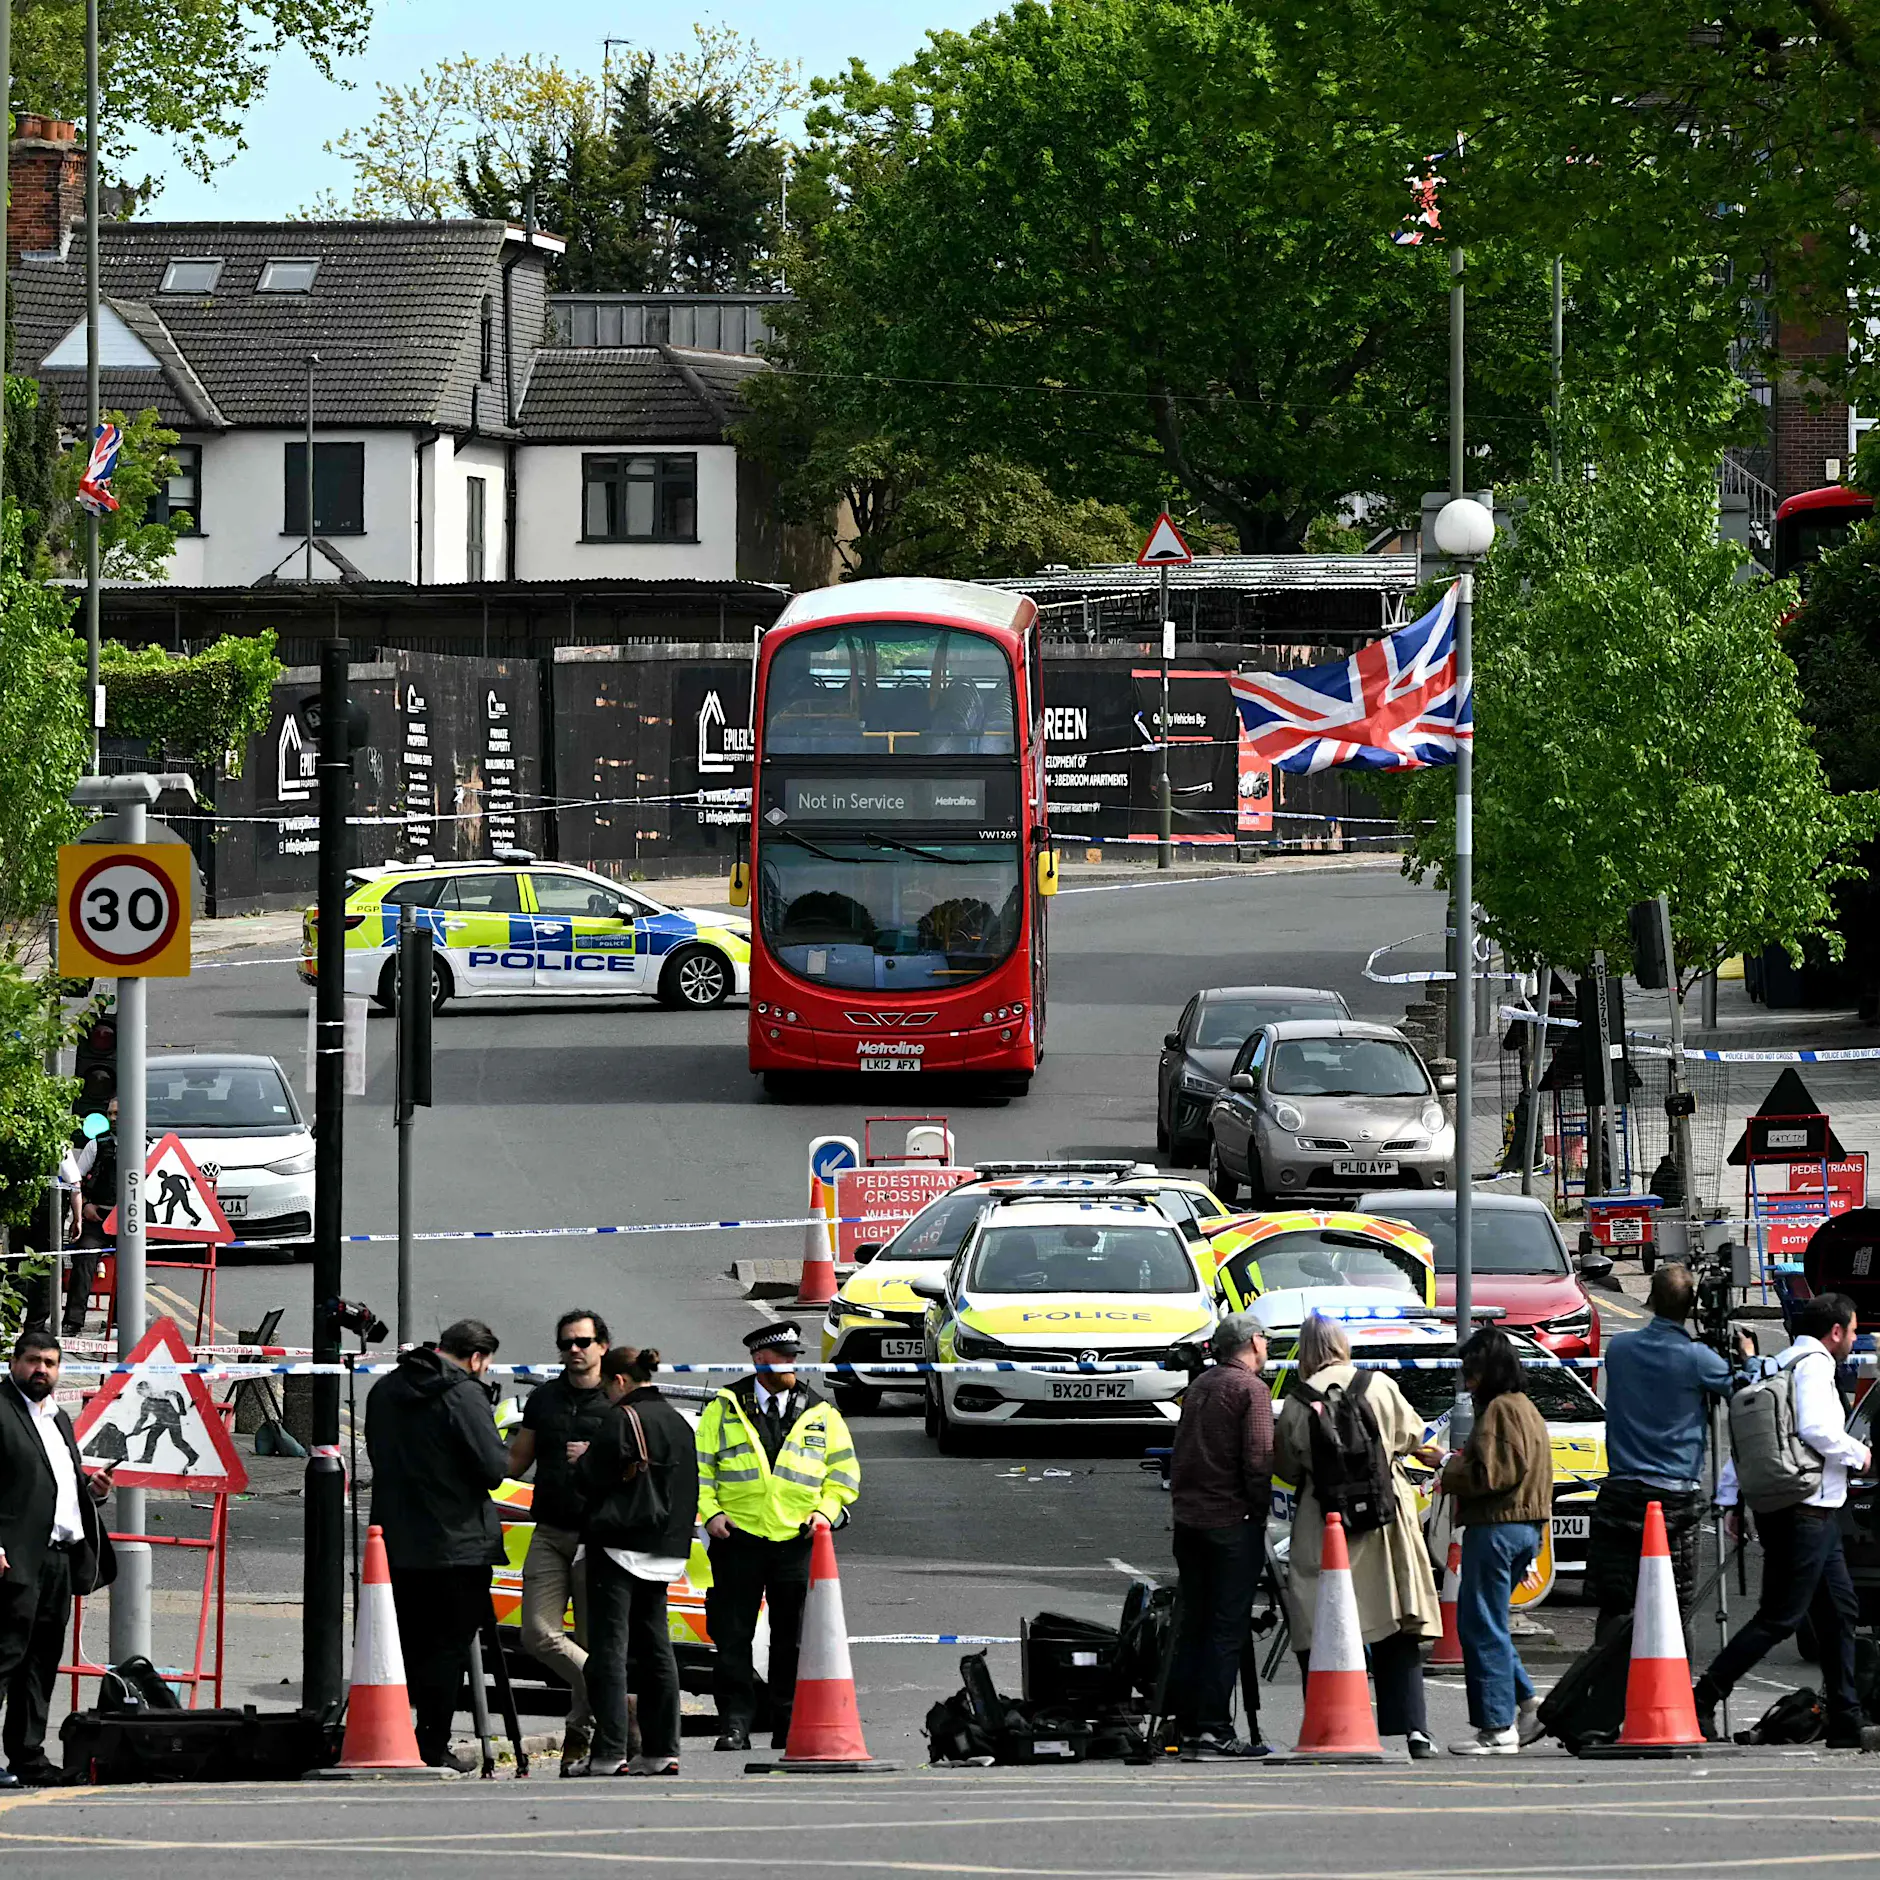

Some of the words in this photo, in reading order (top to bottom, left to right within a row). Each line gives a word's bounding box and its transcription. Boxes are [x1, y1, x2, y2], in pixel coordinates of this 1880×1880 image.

[1174, 713, 1195, 724] Vehicles
[1196, 713, 1206, 728] By:
[408, 722, 426, 734] PRIVATE
[490, 728, 508, 739] PRIVATE
[407, 734, 428, 748] PROPERTY
[488, 740, 511, 752] PROPERTY
[404, 752, 422, 765] BUILDING
[485, 758, 505, 770] BUILDING
[724, 754, 745, 762] PROPERTY
[1078, 756, 1088, 768] OF
[1058, 774, 1089, 786] BEDROOM
[1090, 774, 1128, 787] APARTMENTS
[798, 793, 826, 810] Not
[832, 794, 845, 809] in
[850, 793, 905, 810] Service
[935, 795, 976, 806] Metroline
[978, 830, 1017, 840] VW1269
[86, 887, 164, 932] 30
[468, 952, 636, 972] POLICE
[856, 1040, 925, 1055] Metroline
[1821, 1051, 1839, 1059] POLICE
[1852, 1050, 1860, 1058] DO
[866, 1060, 890, 1070] LK12
[896, 1060, 915, 1070] AFX
[1340, 1162, 1366, 1174] PL10
[1369, 1162, 1392, 1174] AYP
[856, 1174, 957, 1188] PEDESTRIAN
[128, 1172, 138, 1233] S166
[866, 1208, 913, 1220] WHEN
[1782, 1236, 1808, 1245] BOTH
[1022, 1310, 1152, 1322] POLICE
[886, 1342, 923, 1355] LS75
[1052, 1384, 1092, 1398] BX20
[1096, 1384, 1126, 1398] FMZ
